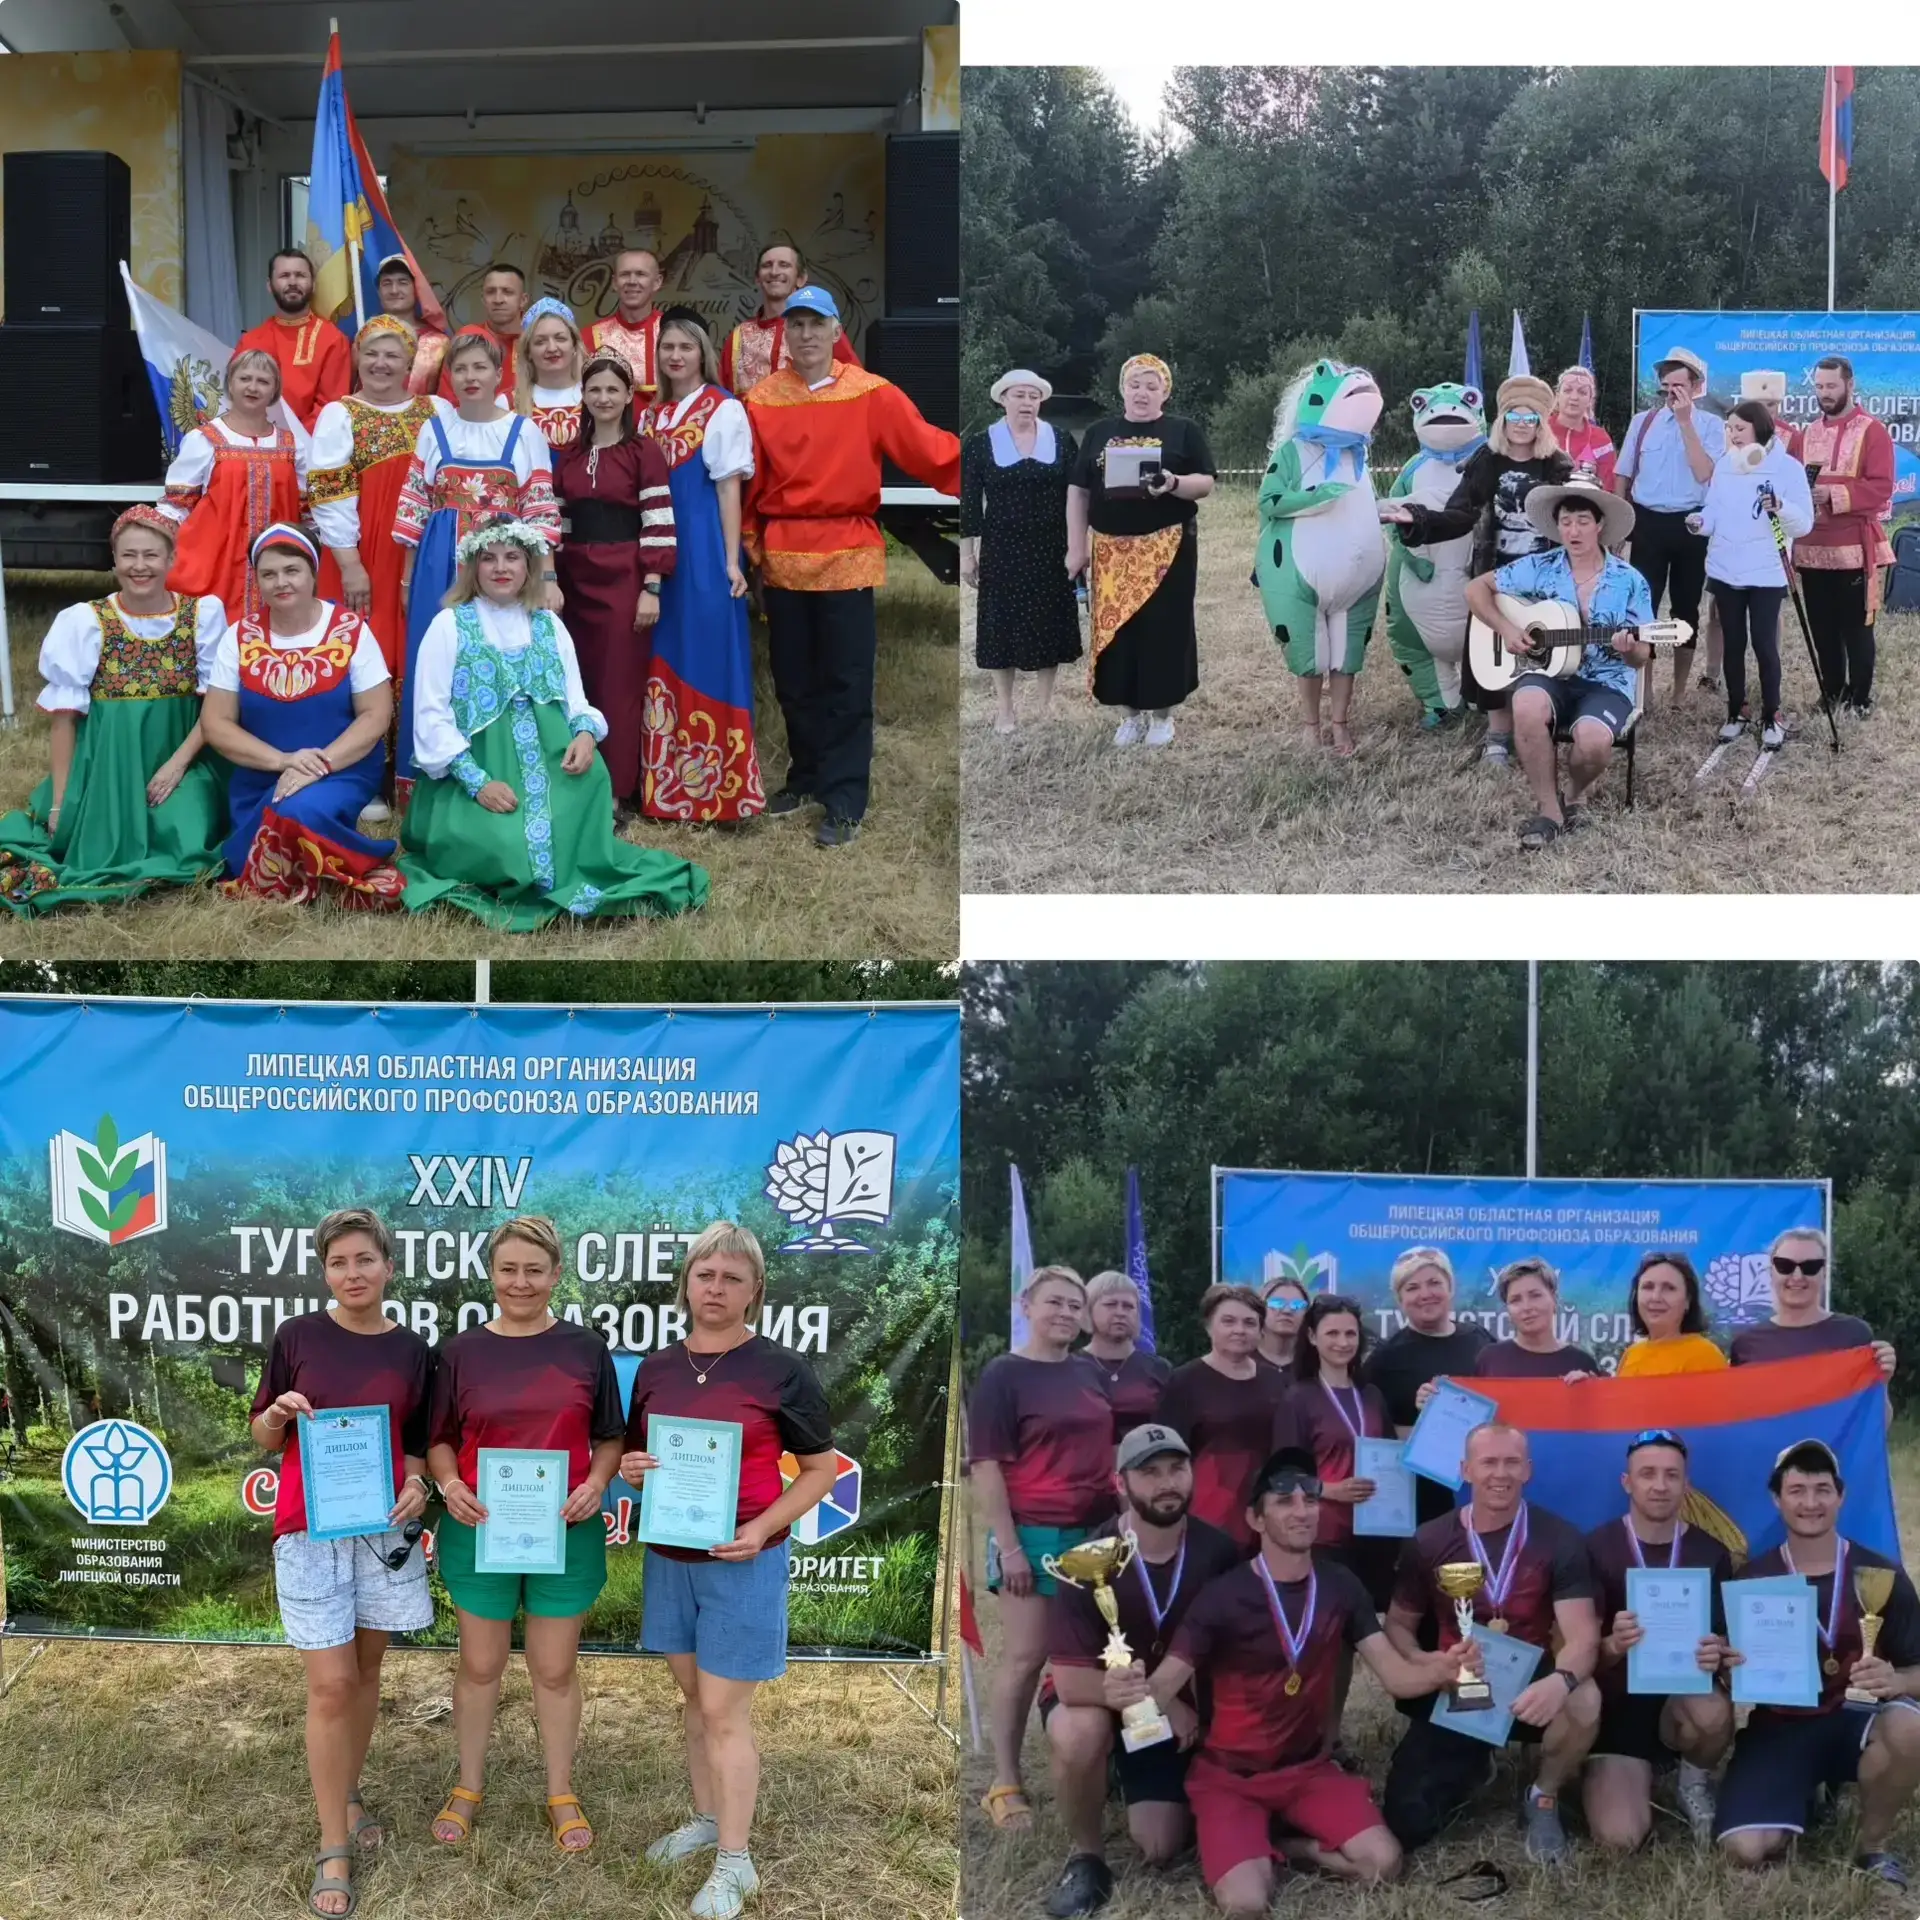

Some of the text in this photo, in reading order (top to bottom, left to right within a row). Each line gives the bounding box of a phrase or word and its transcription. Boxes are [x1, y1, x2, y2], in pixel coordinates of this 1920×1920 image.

[245, 1053, 697, 1085] ЛИПЕЦКАЯ ОБЛАСТНАЯ ОРГАНИЗАЦИЯ
[183, 1082, 760, 1116] ОБЩЕРОССИЙСКОГО ПРОФСОЮЗА ОБРАЗОВАНИЯ
[1388, 1205, 1660, 1225] ЛИПЕЦКАЯ ОБЛАСТНАЯ ОРГАНИЗАЦИЯ
[1349, 1223, 1698, 1244] ОБЩЕРОССИЙСКОГО ПРОФСОЮЗА ОБРАЗОВАНИЯ
[324, 1441, 368, 1455] ДИПЛОМ
[671, 1452, 716, 1465] ДИПЛОМ
[500, 1483, 544, 1493] ДИПЛОМ
[71, 1537, 166, 1552] МИНИСТЕРСТВО
[76, 1553, 163, 1569] ОБРАЗОВАНИЯ
[788, 1555, 885, 1579] ОРИТЕТ
[59, 1569, 180, 1586] ЛИПЕЦКОЙ ОБЛАСТИ
